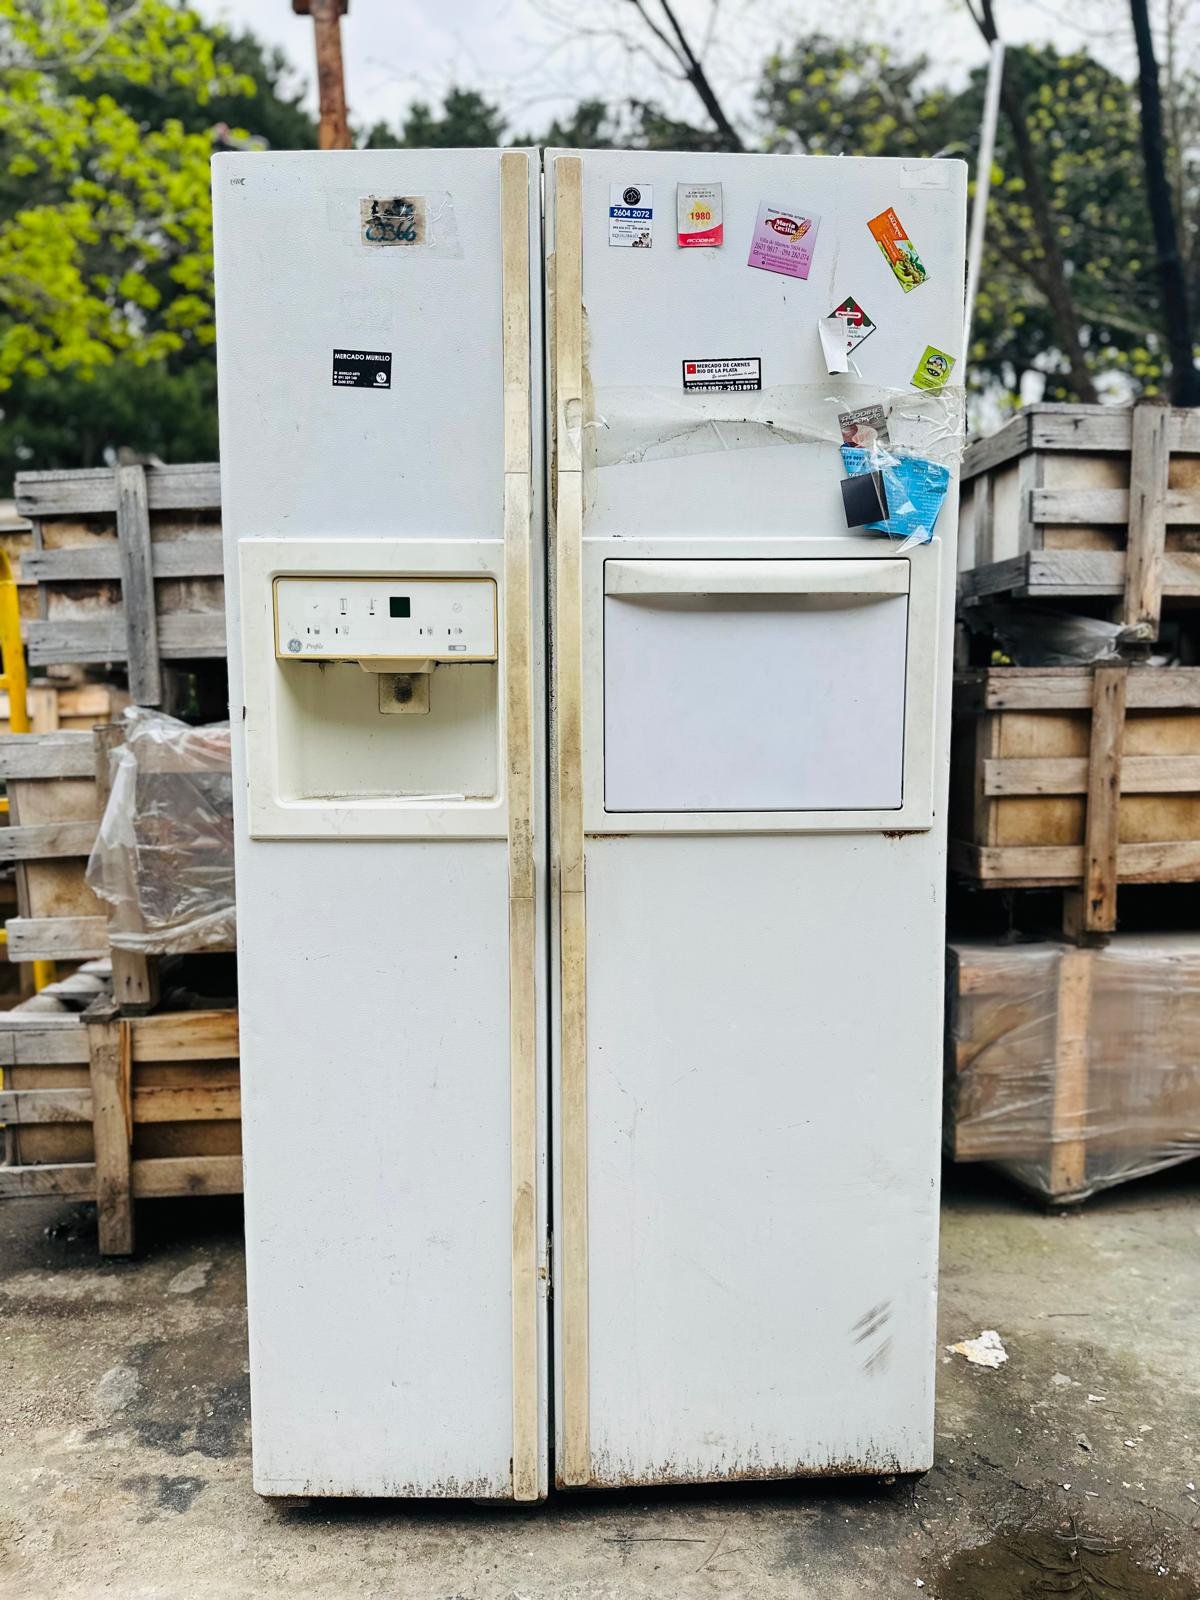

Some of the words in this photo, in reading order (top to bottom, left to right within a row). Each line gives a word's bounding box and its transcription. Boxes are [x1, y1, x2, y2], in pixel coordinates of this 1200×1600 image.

[613, 208, 631, 217] 2604
[633, 209, 650, 218] 2072
[690, 211, 711, 221] 1980
